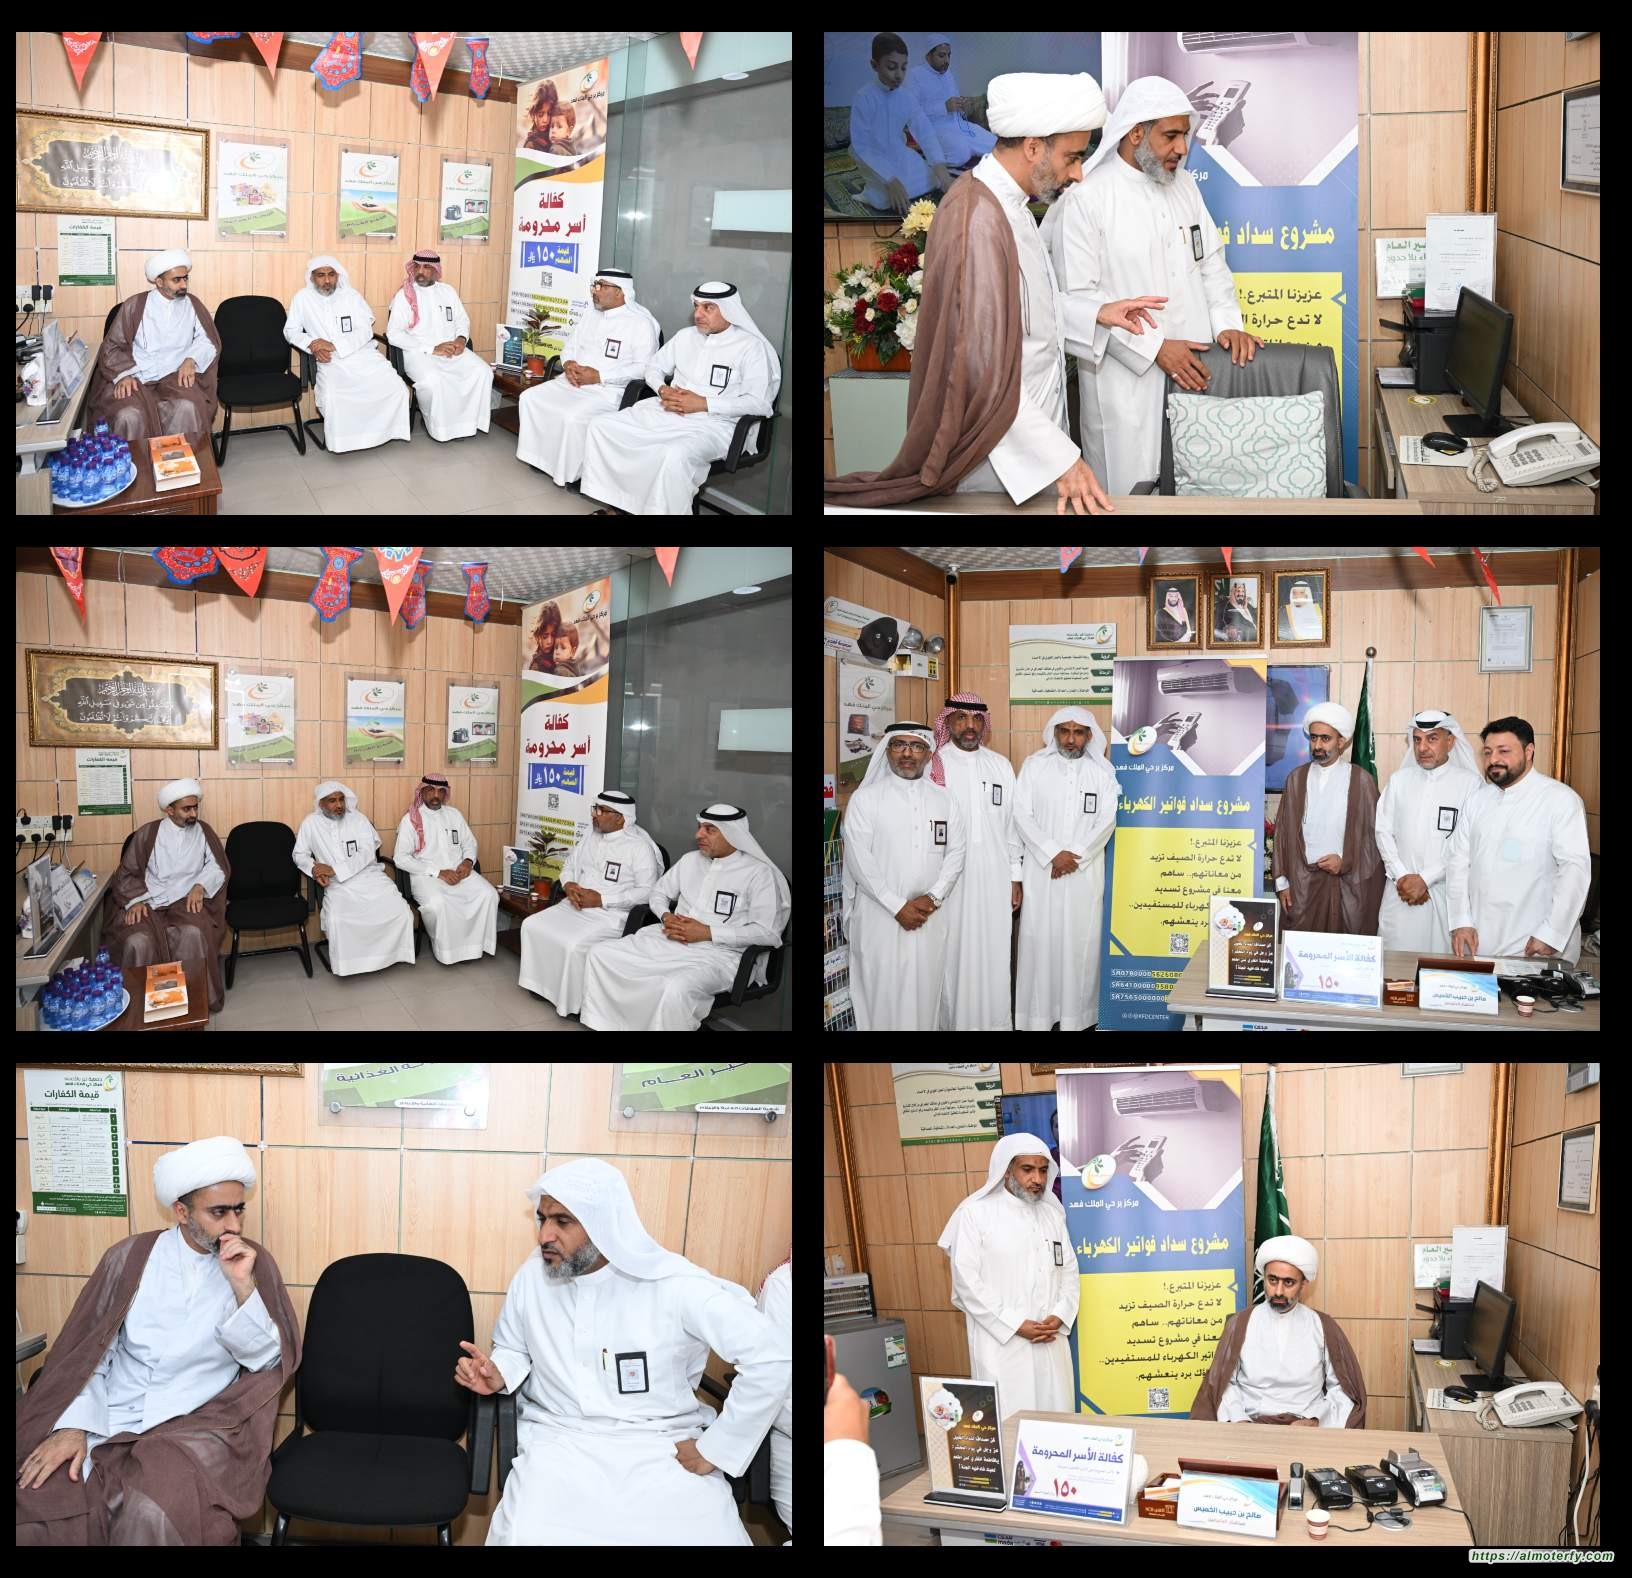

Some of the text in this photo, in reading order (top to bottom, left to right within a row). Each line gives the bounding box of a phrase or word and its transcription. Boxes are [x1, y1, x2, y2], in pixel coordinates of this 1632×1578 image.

[538, 191, 564, 209] كفالة
[518, 213, 586, 237] أسر محرومة
[1237, 219, 1335, 250] مشروع سداد
[536, 244, 555, 264] ١٥٠
[1287, 289, 1322, 300] عزيزنا
[1251, 313, 1323, 330] لا تدع حرارة
[544, 713, 569, 730] كفالة
[525, 735, 591, 758] أسر محرومة
[543, 765, 561, 785] ١٥٠
[1118, 795, 1251, 815] مشروع سداد فواتير الكهرباء
[1298, 950, 1333, 960] المحرومة
[1355, 953, 1376, 963] كفالة
[1318, 974, 1340, 989] ١٥٠
[336, 1064, 399, 1083] الغذائية
[642, 1069, 704, 1088] العام
[44, 1090, 100, 1100] قيمة الكفارات
[1069, 1198, 1139, 1210] مركز بر حي الملك فهد
[1077, 1232, 1229, 1258] مشروع سداد فواتير الكهرباء
[1032, 1445, 1124, 1464] كفالة الأسر المحرومة
[1053, 1478, 1077, 1498] ١٥٠
[1193, 1504, 1218, 1514] الخميس
[1219, 1508, 1237, 1517] حبيب
[1246, 1512, 1262, 1520] صالح
